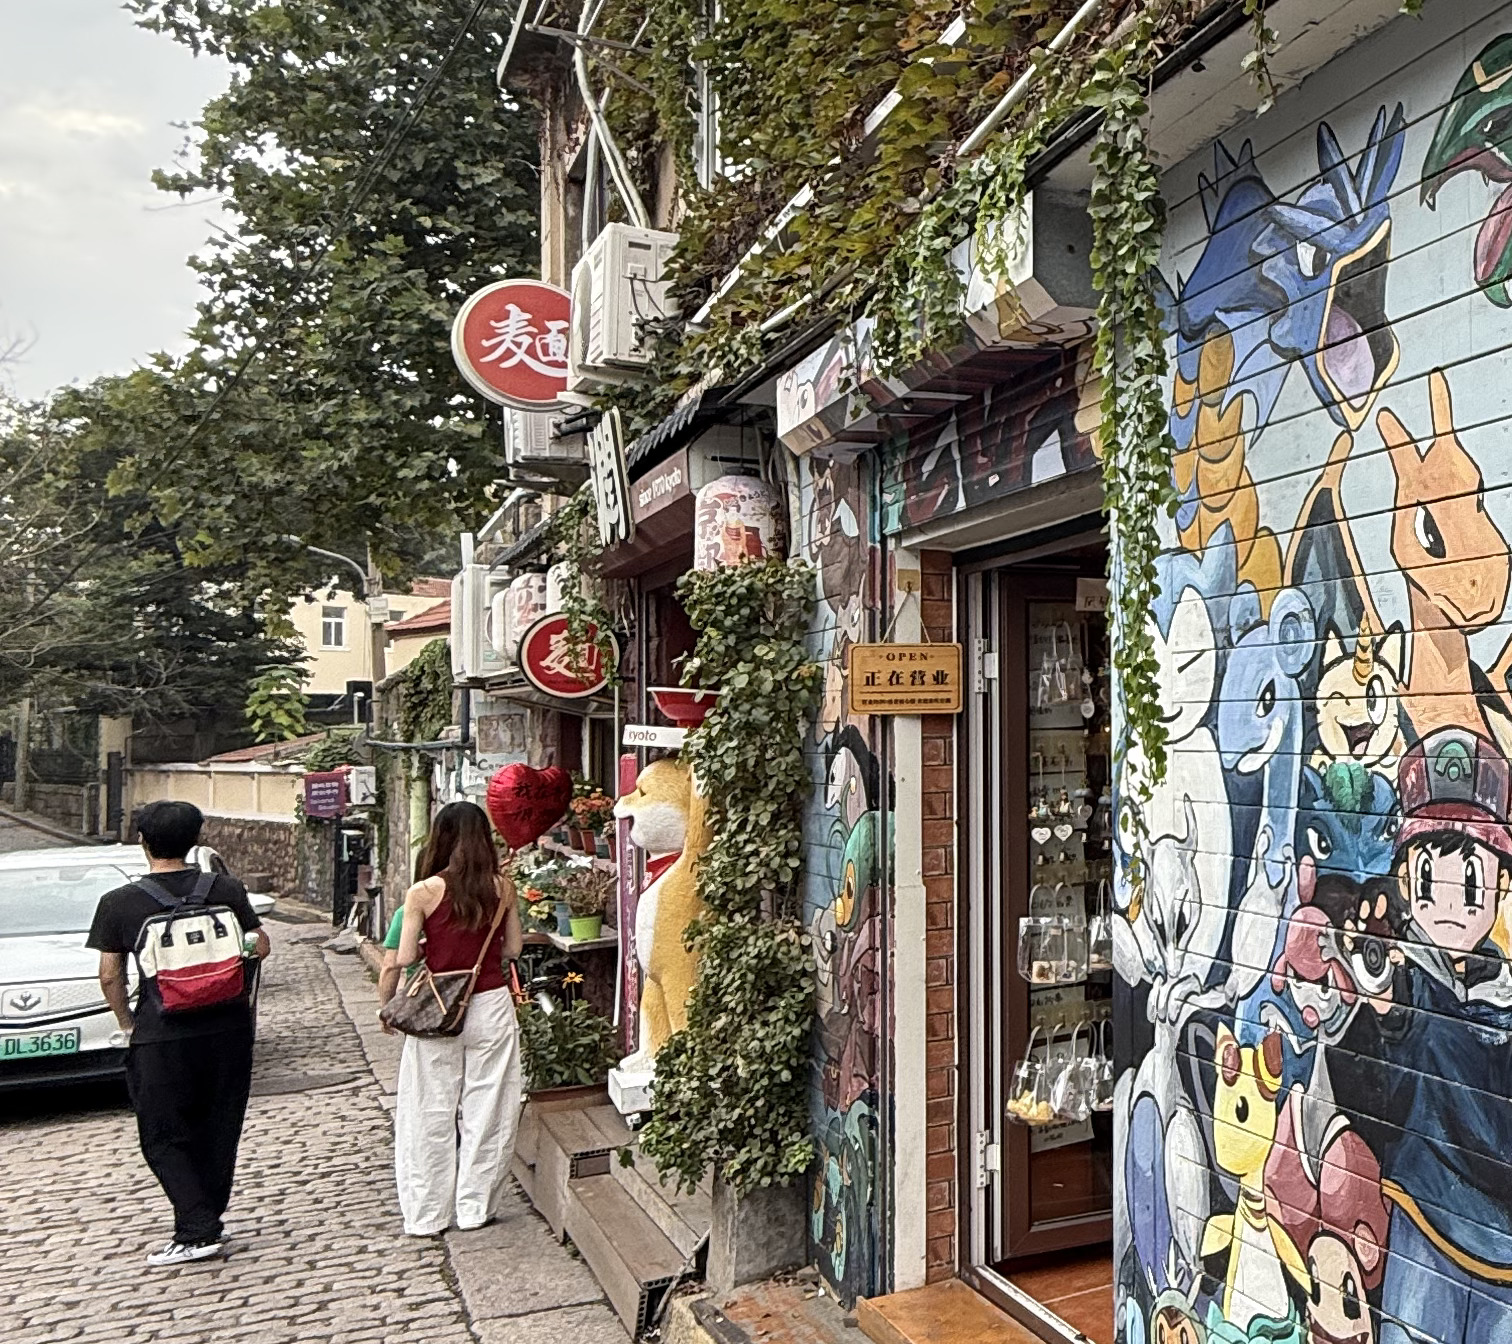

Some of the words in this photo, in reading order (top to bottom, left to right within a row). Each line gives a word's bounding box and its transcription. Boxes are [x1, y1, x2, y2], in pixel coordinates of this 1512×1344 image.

[886, 652, 928, 661] OPEN
[863, 670, 950, 686] 正在营业
[4, 1033, 75, 1056] DL3636
